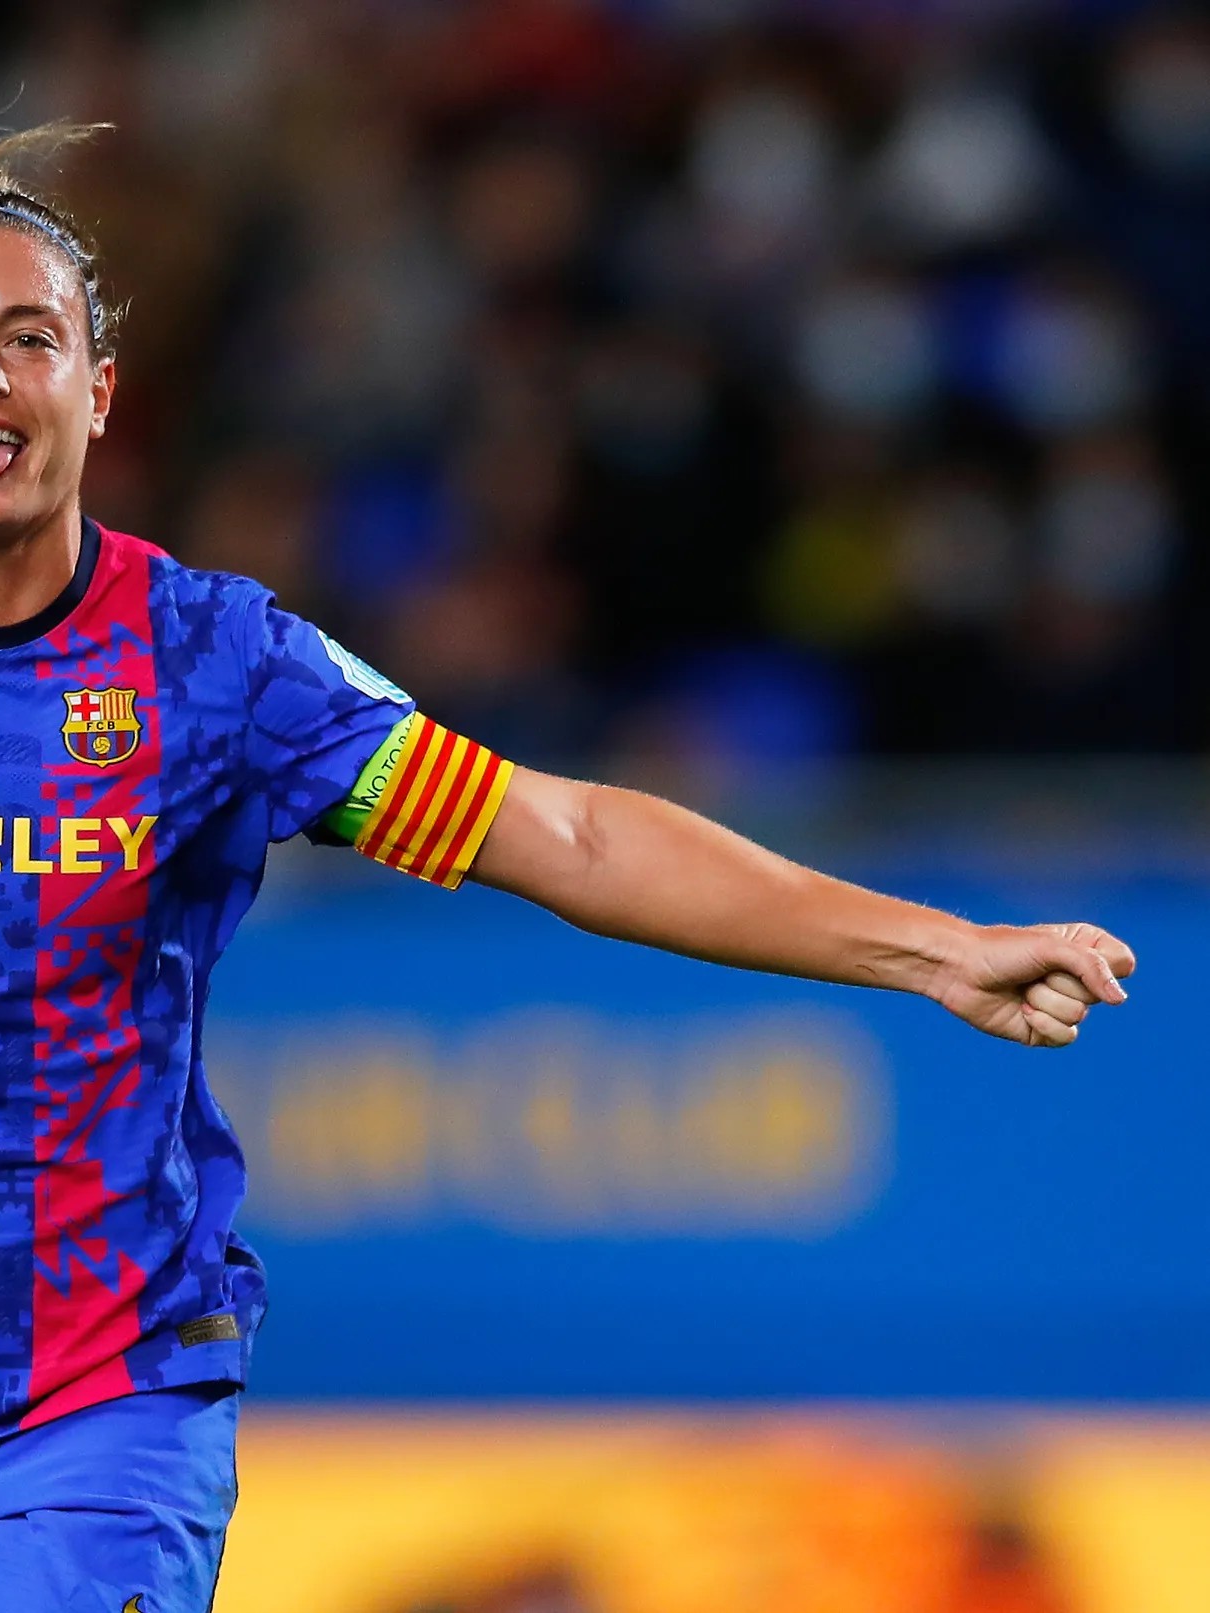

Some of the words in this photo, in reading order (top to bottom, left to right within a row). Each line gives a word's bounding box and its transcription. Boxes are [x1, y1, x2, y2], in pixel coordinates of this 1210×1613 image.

[86, 721, 115, 731] FCB
[360, 775, 387, 808] NO
[381, 749, 401, 770] TO
